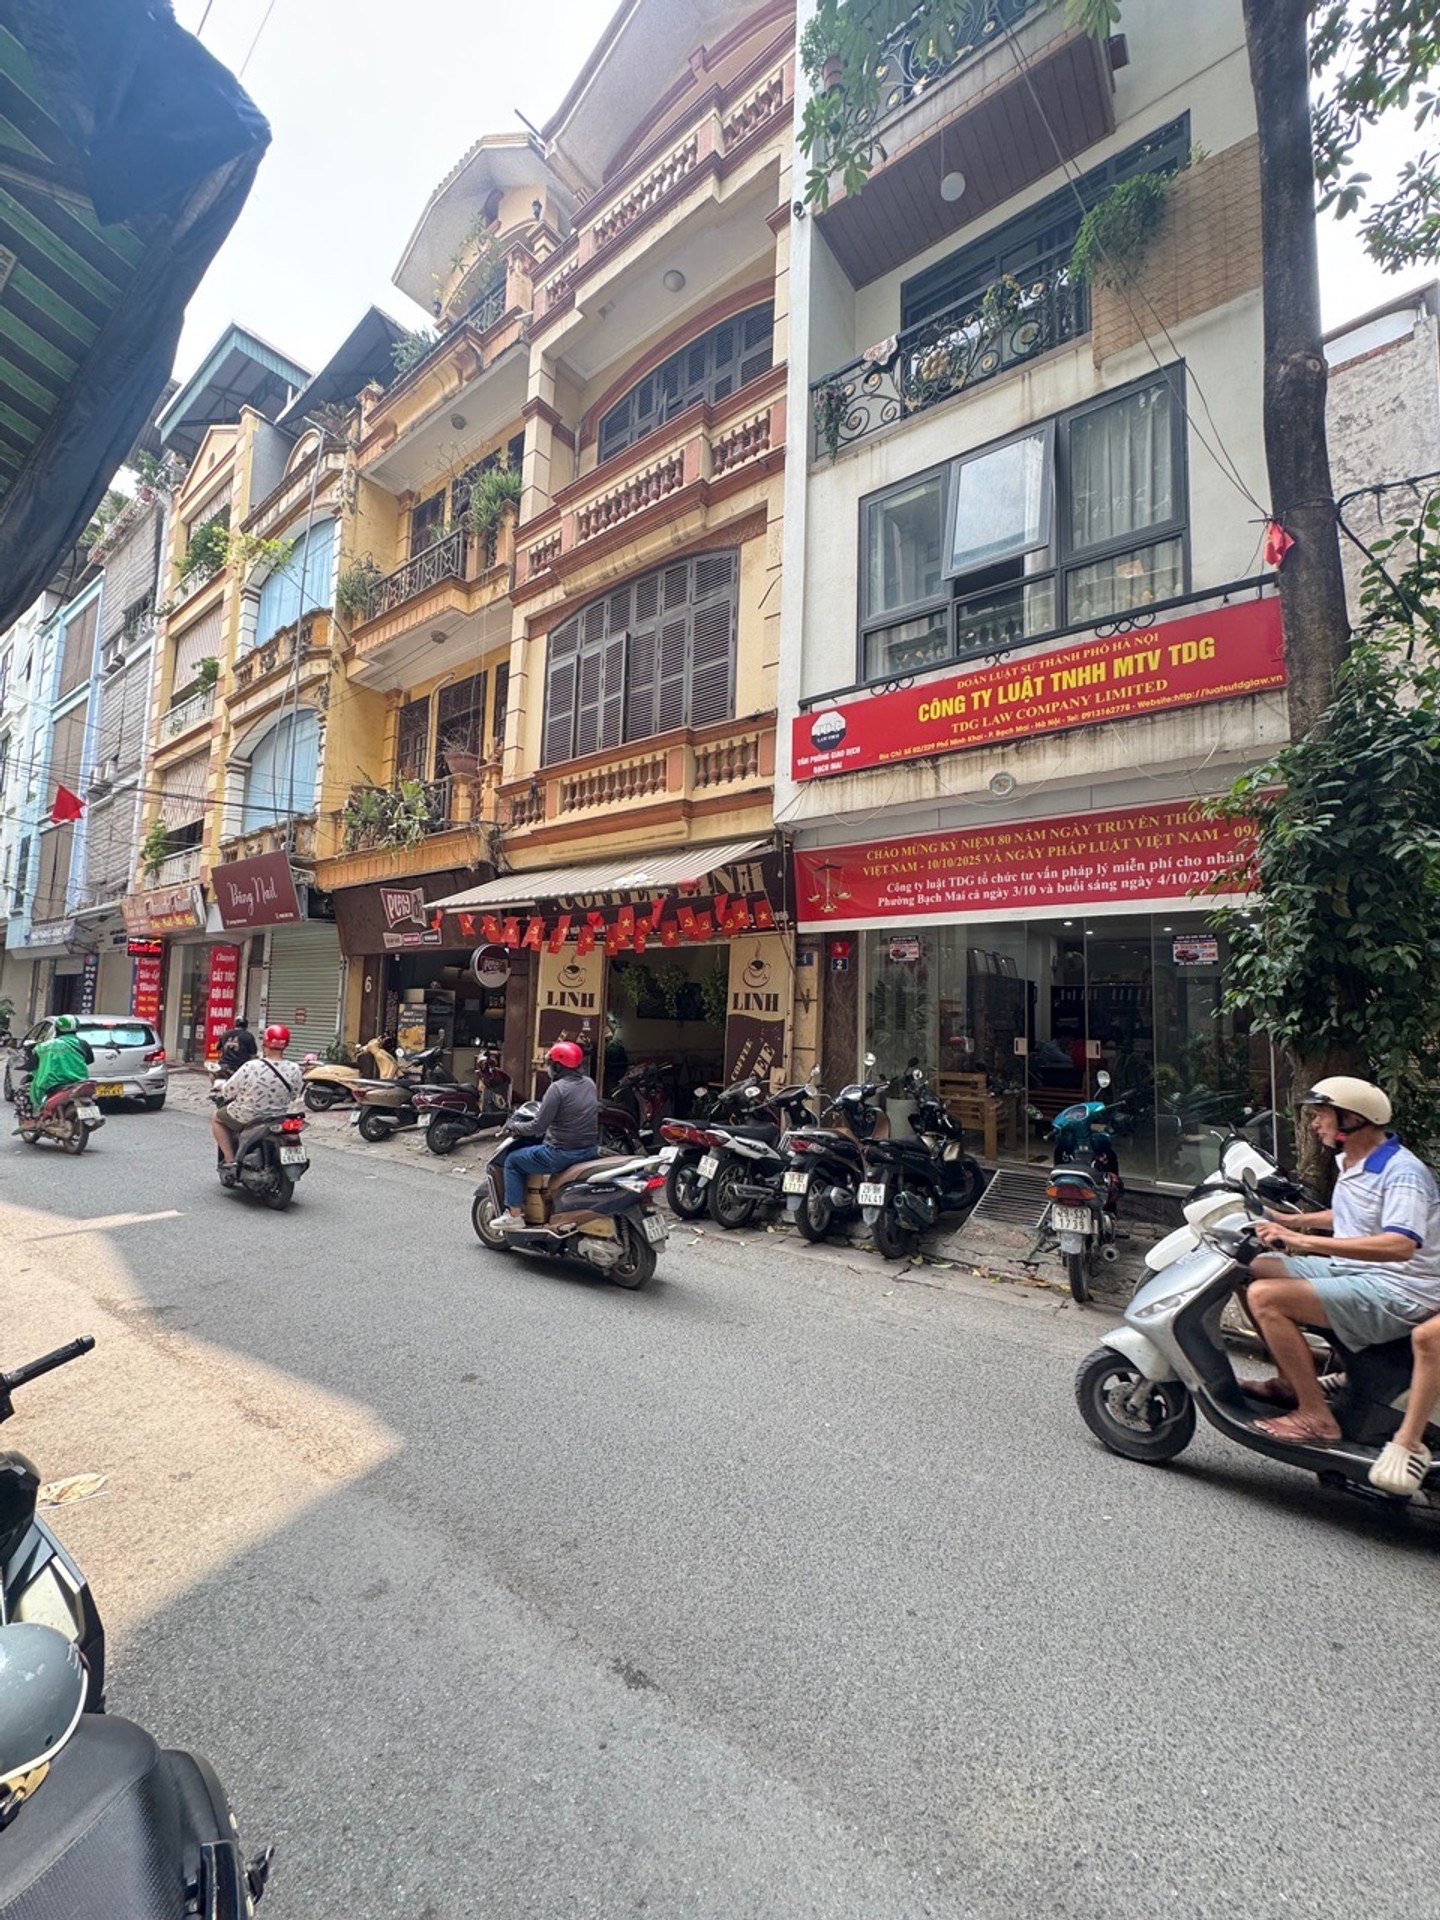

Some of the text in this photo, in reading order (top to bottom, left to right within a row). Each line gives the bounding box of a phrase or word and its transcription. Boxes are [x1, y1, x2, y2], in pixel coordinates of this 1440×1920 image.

[989, 665, 1018, 682] LUẬT
[1038, 650, 1080, 669] THÀNH
[1083, 642, 1110, 659] PHỐ
[1112, 637, 1132, 652] HÀ
[1134, 632, 1159, 649] NỘI
[918, 637, 1216, 722] CÔNG TY LUẬT TNHH MTV TDG
[951, 678, 1169, 734] TDG LAW COMPANY LIMITED
[863, 864, 888, 878] VIỆT
[890, 862, 918, 874] NAM
[927, 853, 981, 870] 10/10/2025
[983, 849, 1003, 863] VÀ
[1006, 844, 1048, 861] NGÀY
[1048, 840, 1086, 858] PHÁP
[1089, 837, 1131, 855] LUẬT
[1135, 832, 1174, 849] VIỆT
[1178, 828, 1218, 844] NAM
[866, 846, 899, 861] CHÀO
[961, 834, 995, 850] NIỆM
[997, 833, 1011, 846] 80
[1013, 828, 1046, 844] NĂM
[1051, 822, 1091, 840] NGÀY
[878, 894, 914, 908] Phường
[917, 892, 942, 905] Bạch
[944, 889, 966, 902] Mai
[983, 888, 1008, 901] ngày
[1012, 884, 1036, 898] 3/10
[1039, 882, 1054, 894] và
[1057, 877, 1084, 894] buổi
[1088, 877, 1117, 893] sáng
[1121, 874, 1151, 891] ngày
[887, 882, 912, 894] Công
[914, 881, 924, 892] ty
[926, 876, 946, 889] luật
[948, 875, 974, 887] TDG
[991, 871, 1018, 883] chức
[1036, 864, 1058, 879] vấn
[1062, 863, 1092, 880] pháp
[1097, 862, 1108, 877] lý
[1113, 857, 1145, 874] miễn
[1150, 855, 1172, 873] phí
[1176, 855, 1202, 868] cho
[836, 959, 843, 970] 2
[364, 975, 372, 992] 6
[547, 990, 595, 1008] LINH
[210, 1007, 232, 1018] NAM
[732, 992, 779, 1012] LINH
